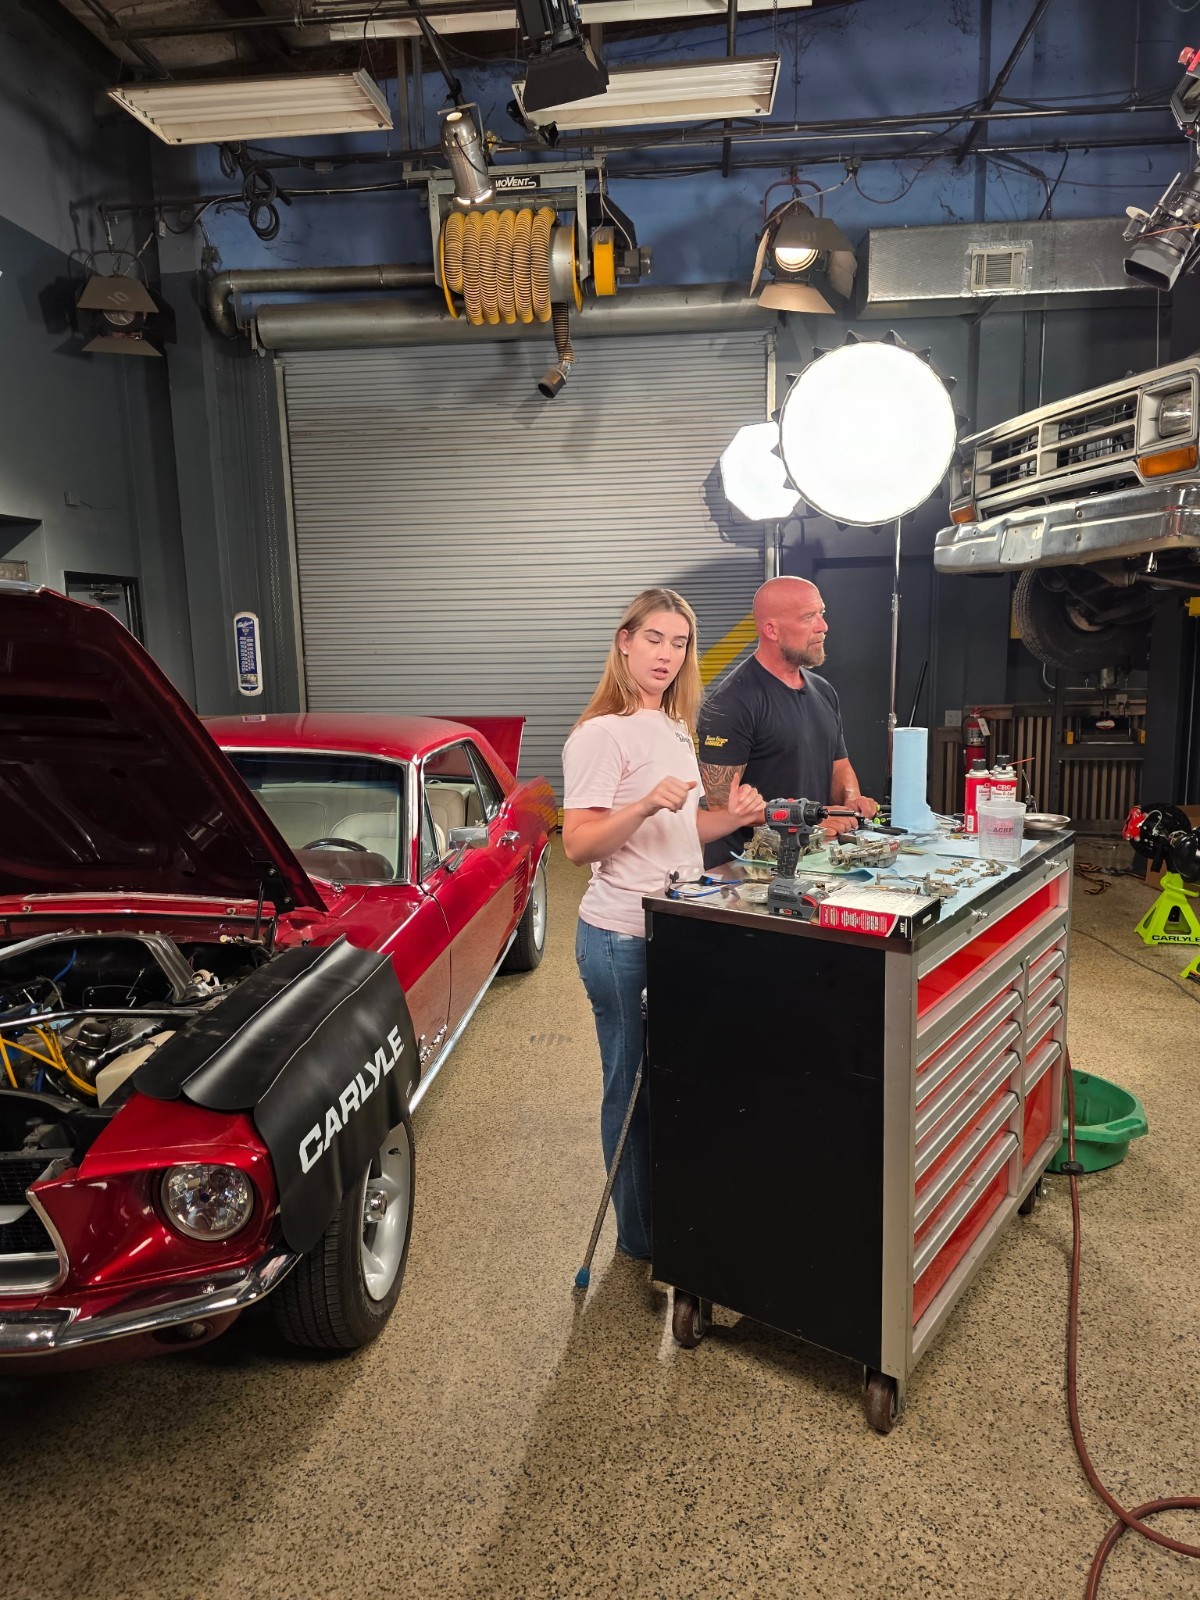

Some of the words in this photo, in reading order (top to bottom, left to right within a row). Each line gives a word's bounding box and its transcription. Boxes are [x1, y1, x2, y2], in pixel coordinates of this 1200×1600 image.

[495, 176, 530, 187] MOVENT
[107, 291, 130, 305] 10
[298, 1024, 405, 1174] CARLYLE
